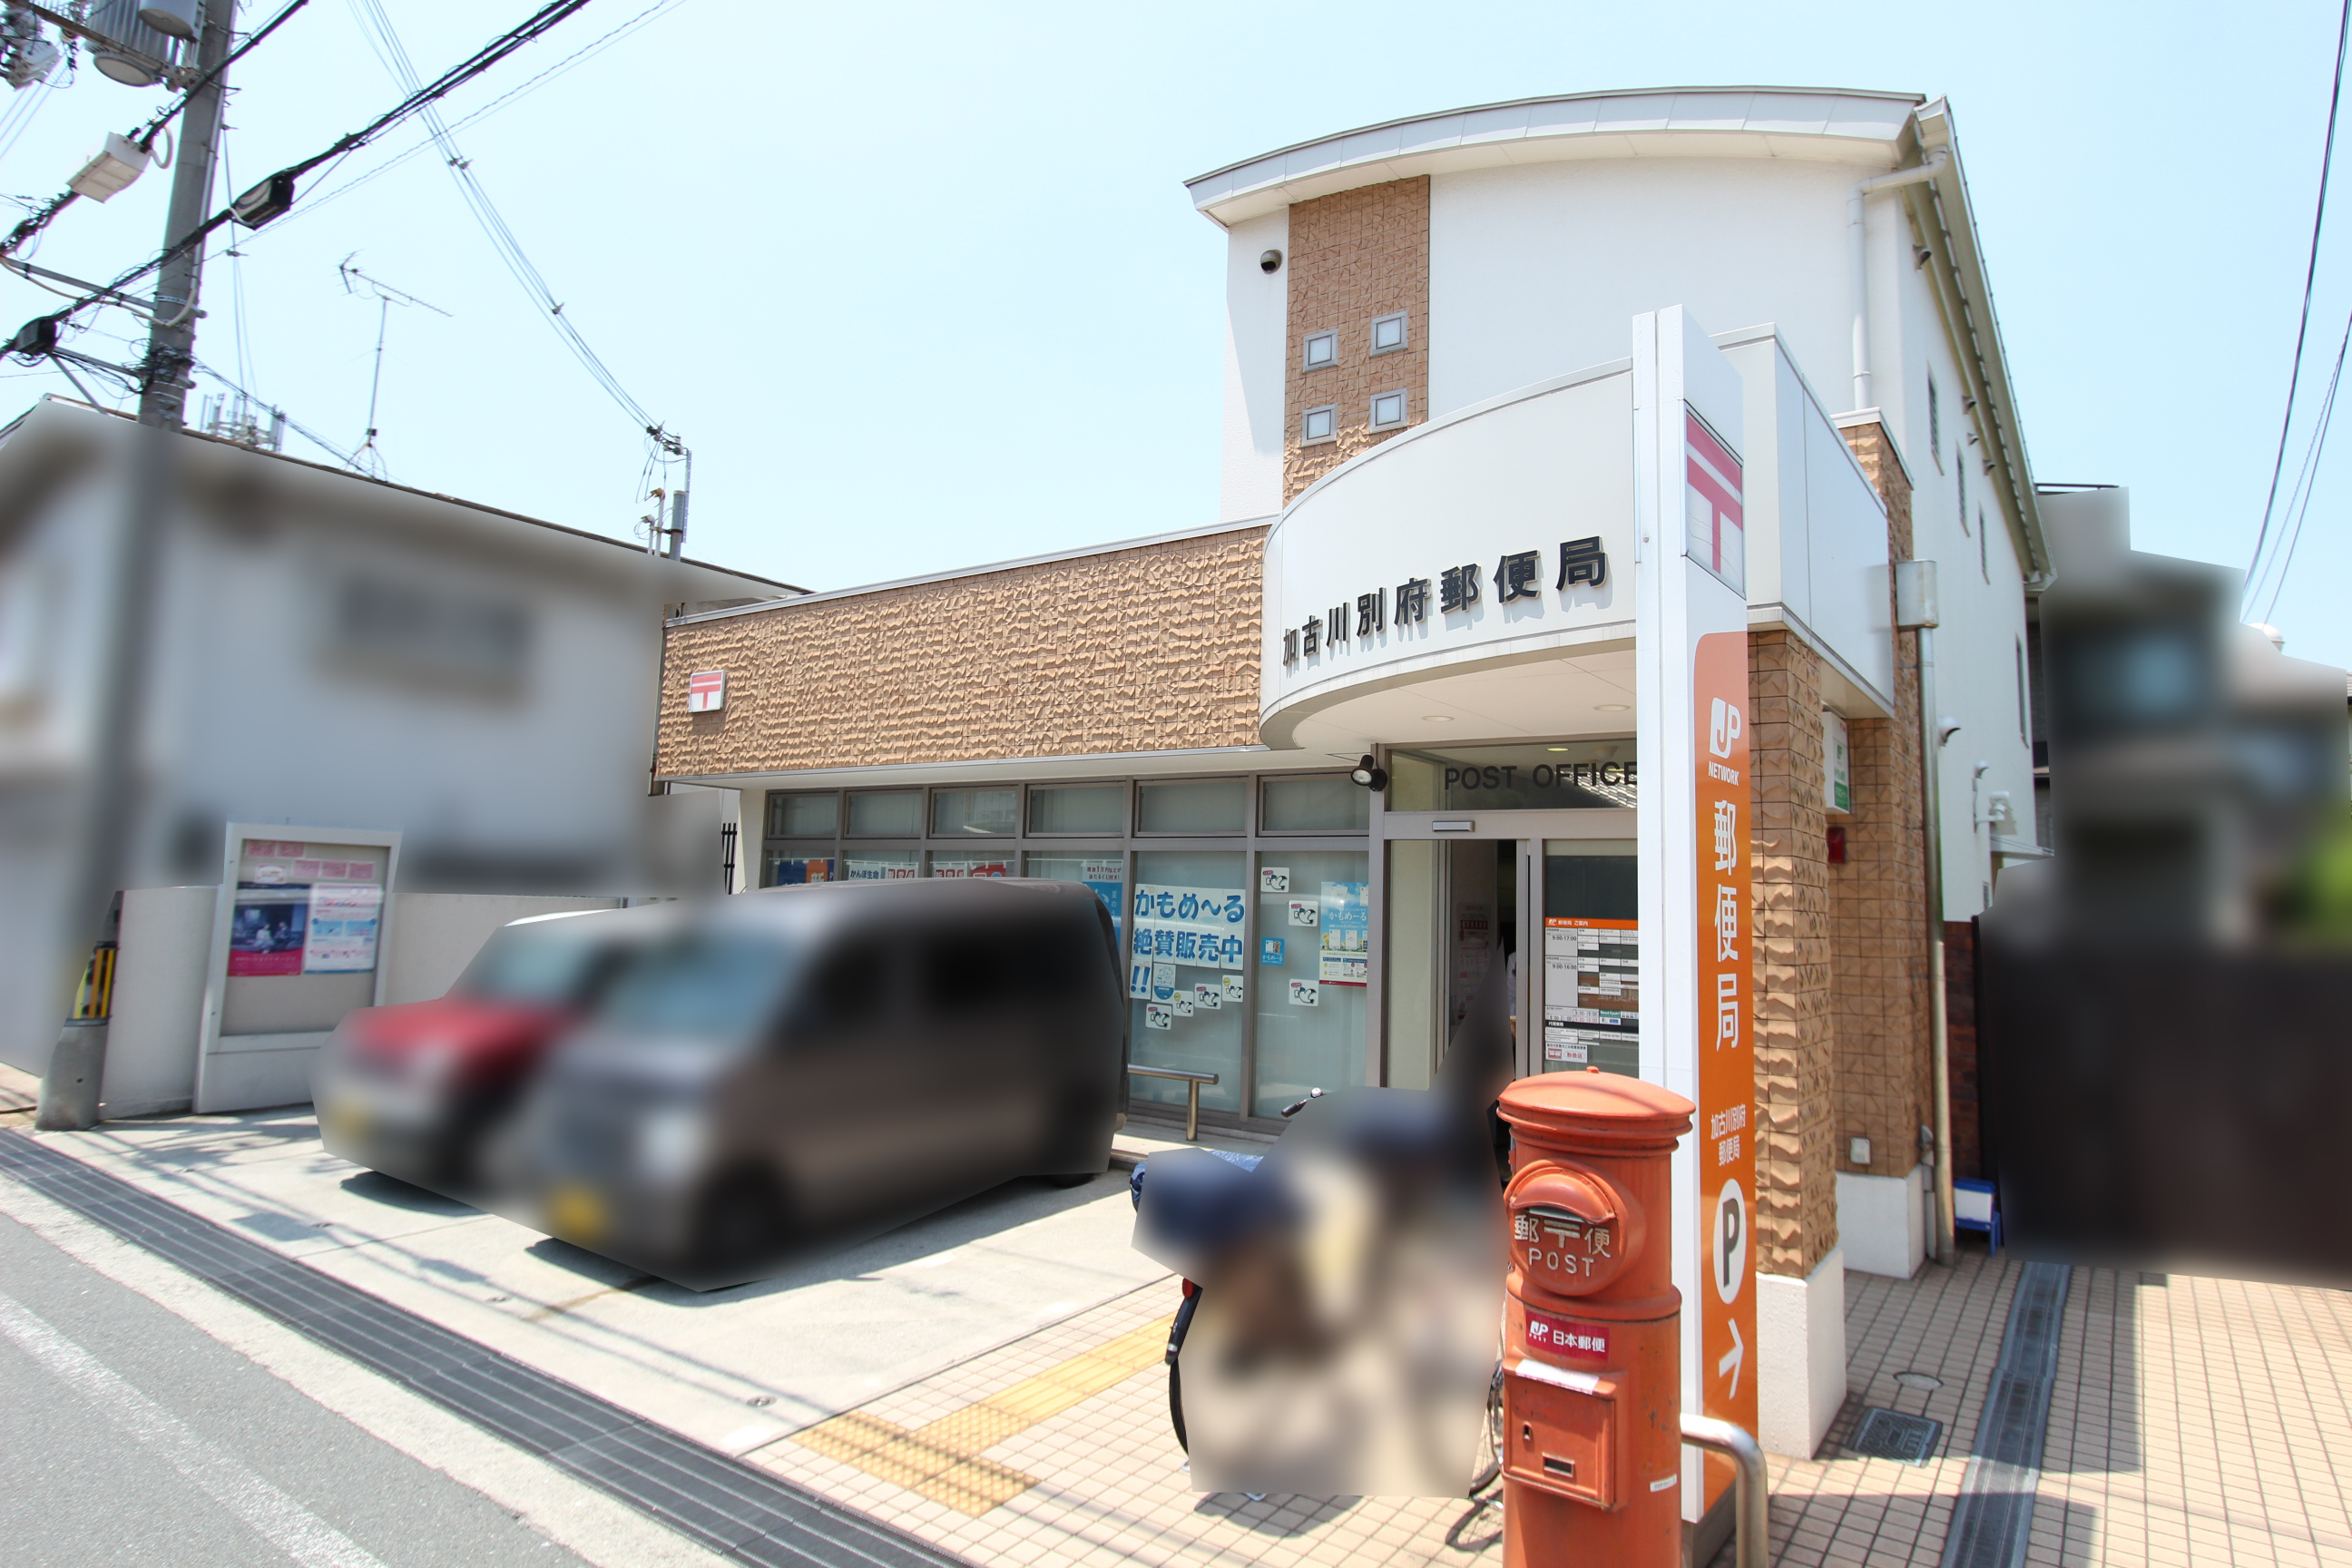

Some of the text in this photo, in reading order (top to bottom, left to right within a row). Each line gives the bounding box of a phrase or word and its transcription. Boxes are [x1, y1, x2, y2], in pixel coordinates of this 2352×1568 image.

[1283, 535, 1607, 666] 加古川別府郵便局
[1445, 761, 1637, 790] POST OFFICE
[1709, 760, 1740, 786] NETWORK
[850, 870, 879, 879] かんぽ生命
[1713, 799, 1740, 1052] 郵便局
[1133, 927, 1242, 963] 絶賛販売中
[1710, 1103, 1747, 1141] 加古川別府
[1718, 1135, 1740, 1167] 郵便局
[1529, 1247, 1594, 1277] POST
[1553, 1329, 1606, 1353] 日本郵便
